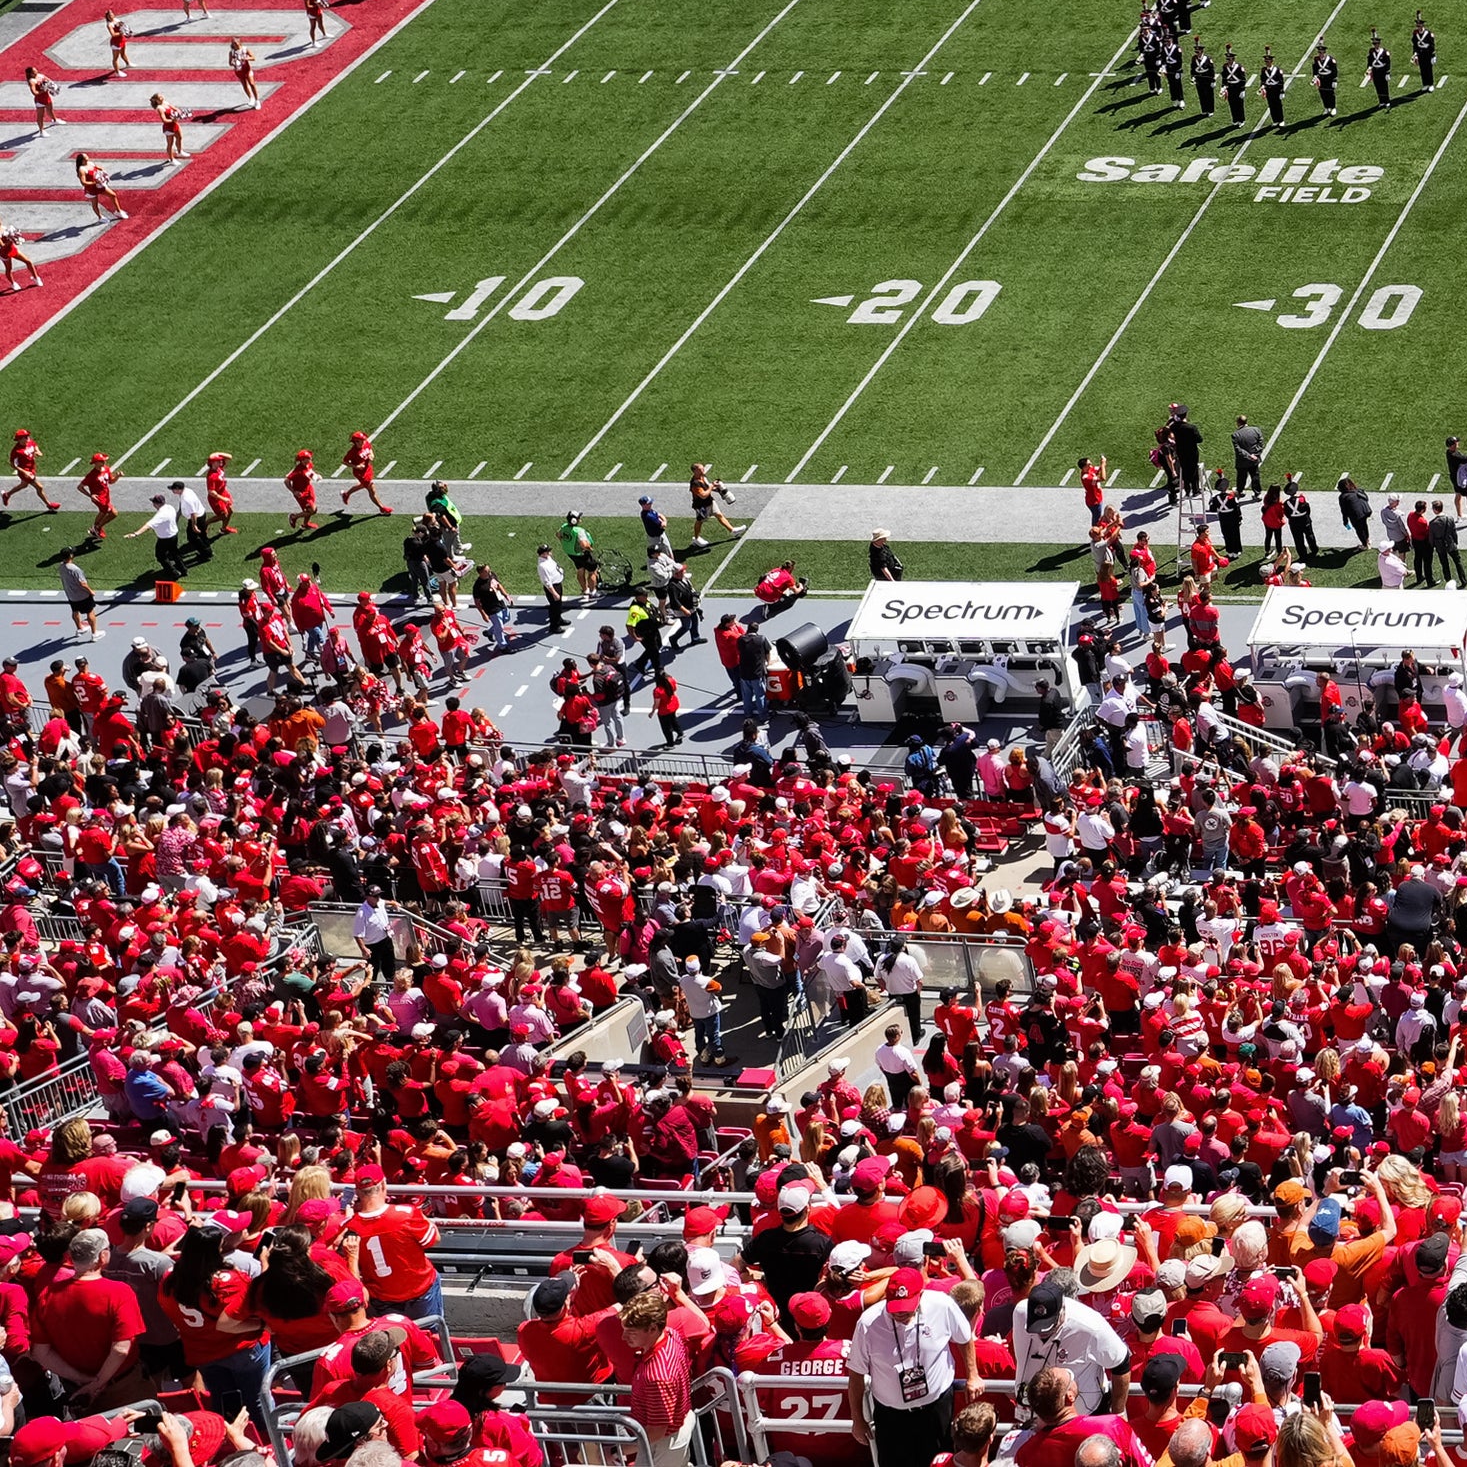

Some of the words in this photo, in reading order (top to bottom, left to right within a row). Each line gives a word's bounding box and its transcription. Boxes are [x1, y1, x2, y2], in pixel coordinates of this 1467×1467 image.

[1075, 155, 1386, 184] Safelite
[1252, 186, 1372, 204] FIELD
[444, 275, 586, 321] 10
[847, 280, 1002, 325] 20
[1276, 283, 1424, 330] 30
[881, 599, 1033, 626] Spectrum
[1281, 604, 1437, 630] Spectrum
[766, 675, 783, 693] G
[541, 884, 562, 902] 12
[944, 1018, 954, 1037] 1
[992, 1018, 1006, 1041] 2
[1208, 1012, 1218, 1028] 1
[1028, 1023, 1045, 1044] 4
[367, 1236, 393, 1278] 1
[179, 1303, 205, 1328] 5
[780, 1358, 844, 1376] GEORGE
[780, 1393, 844, 1436] 27
